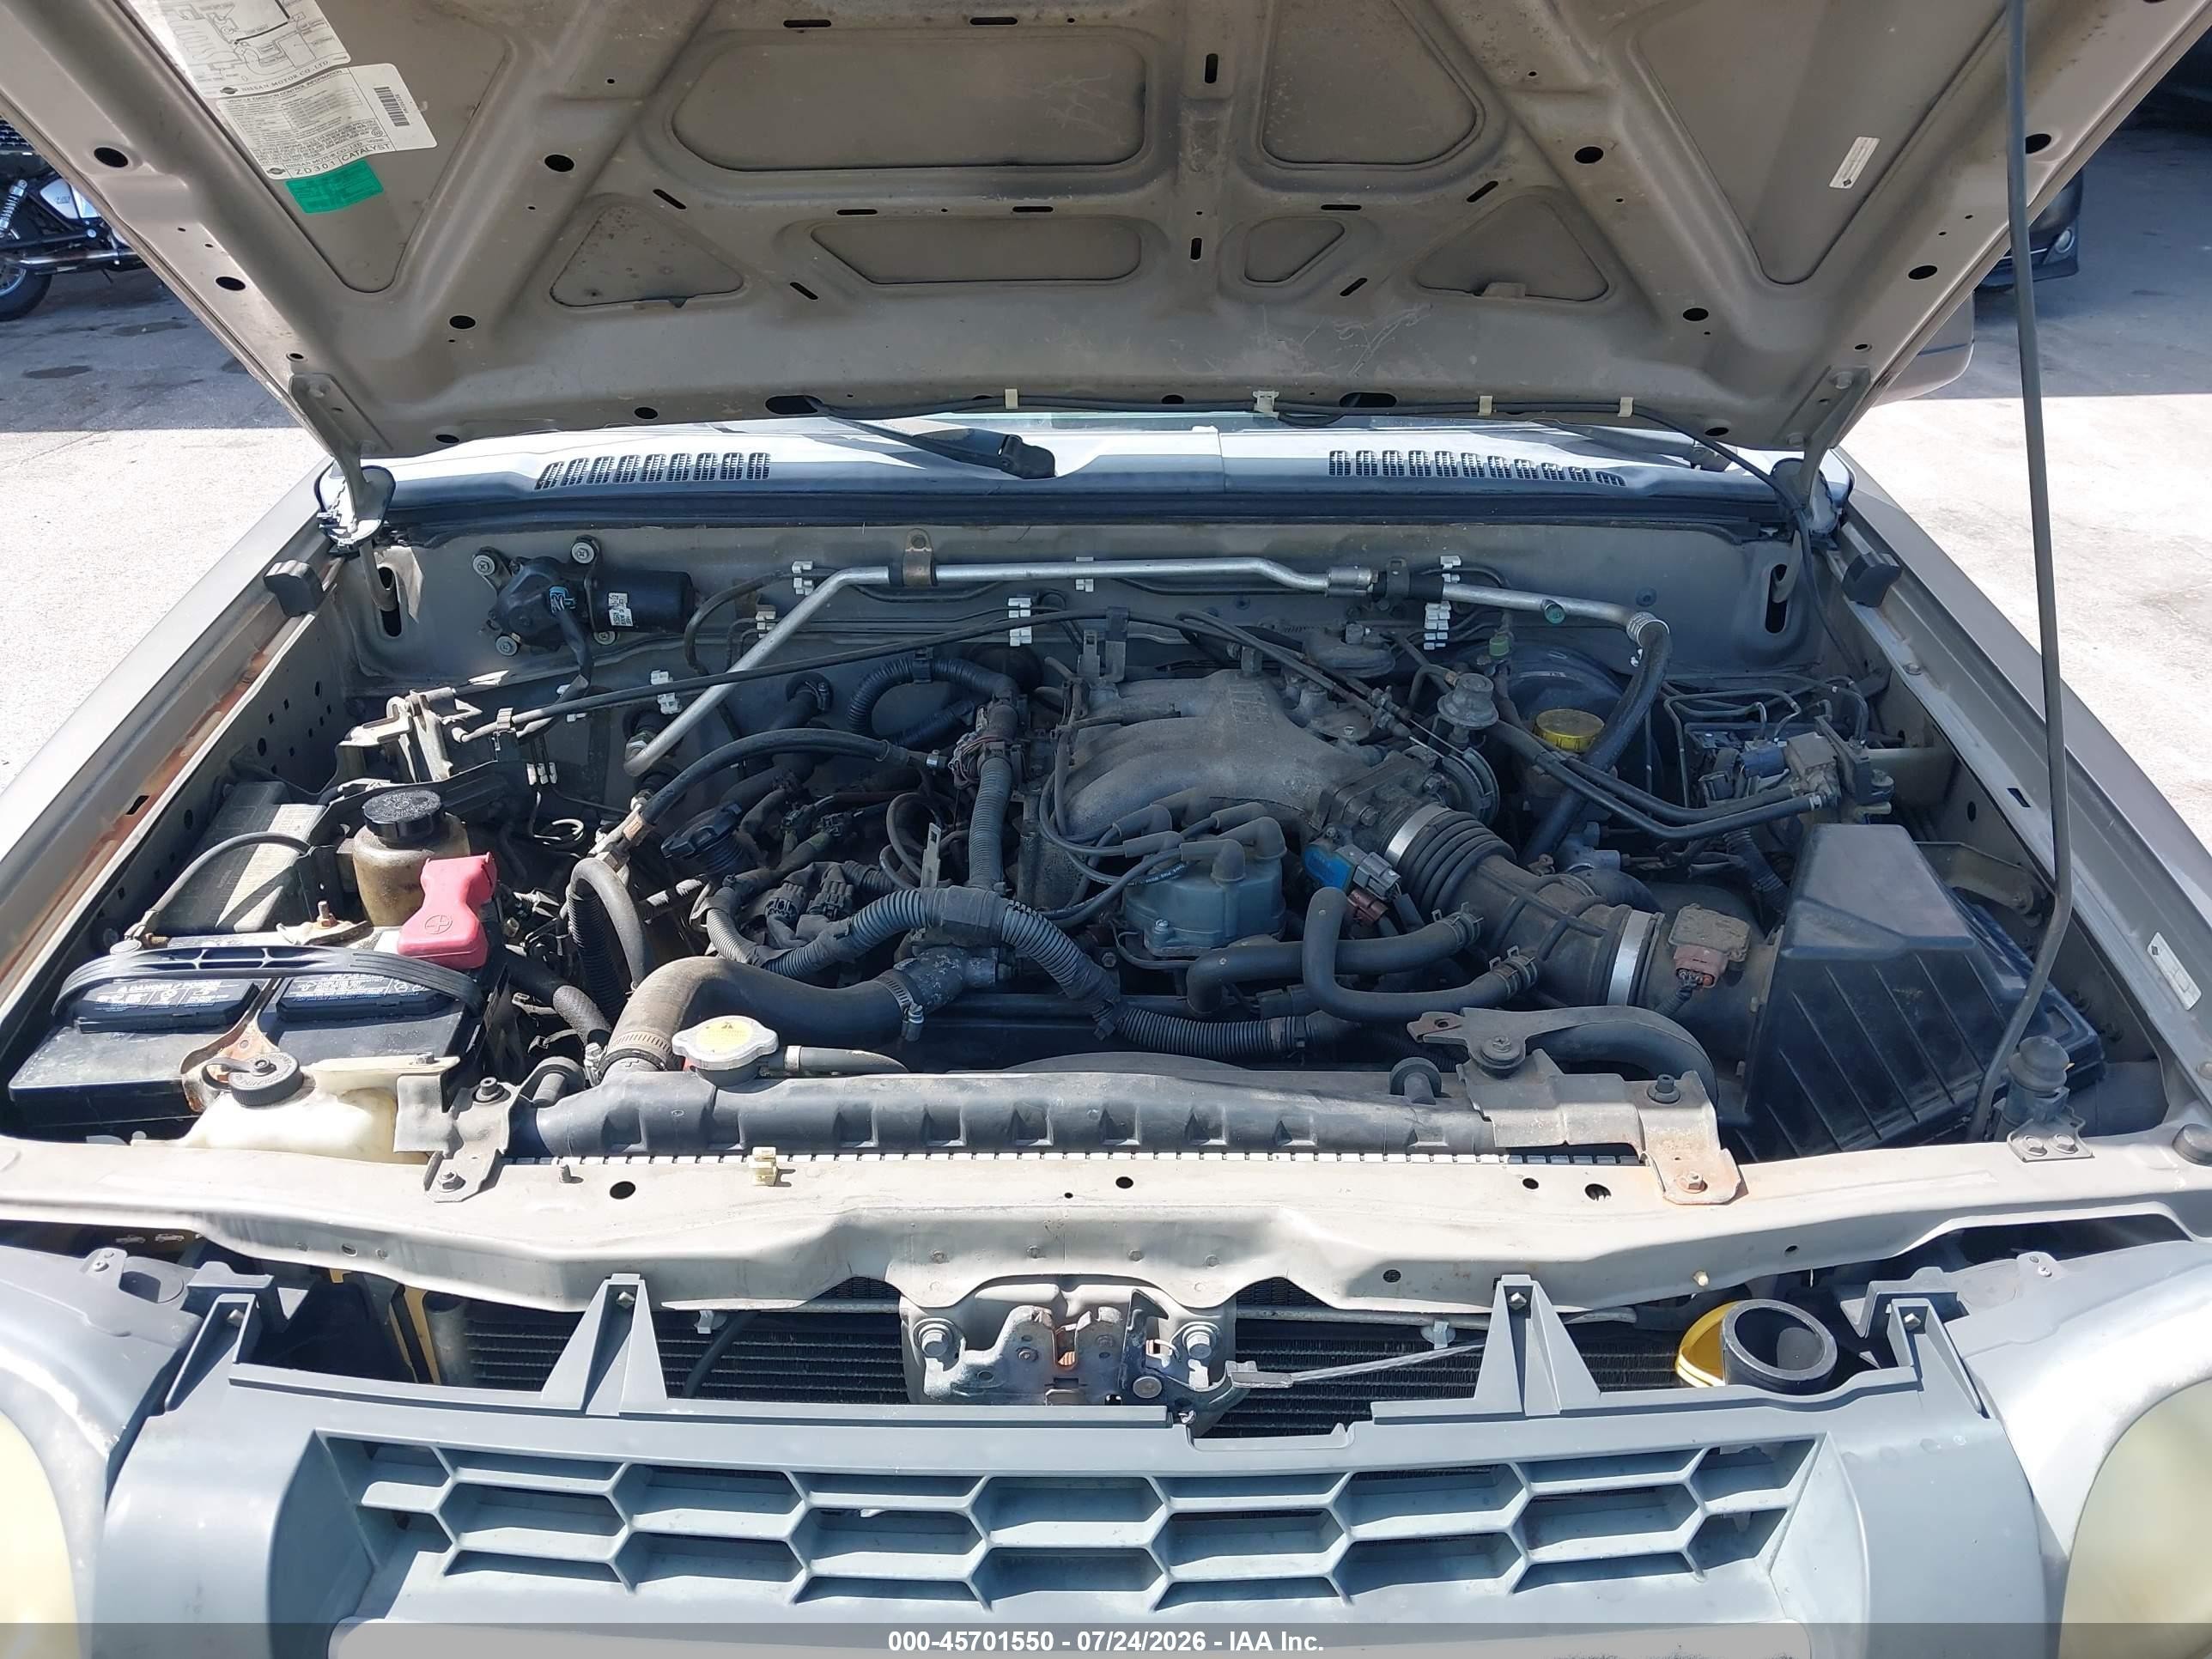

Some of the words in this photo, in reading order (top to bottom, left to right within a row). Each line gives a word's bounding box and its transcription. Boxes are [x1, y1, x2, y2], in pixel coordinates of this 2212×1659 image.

[241, 83, 270, 92] NISSAN
[271, 75, 299, 87] MOTOR
[286, 161, 311, 169] NISSAN
[312, 153, 336, 163] MOTOR
[295, 160, 337, 175] ZD301
[341, 143, 391, 161] CATALYST
